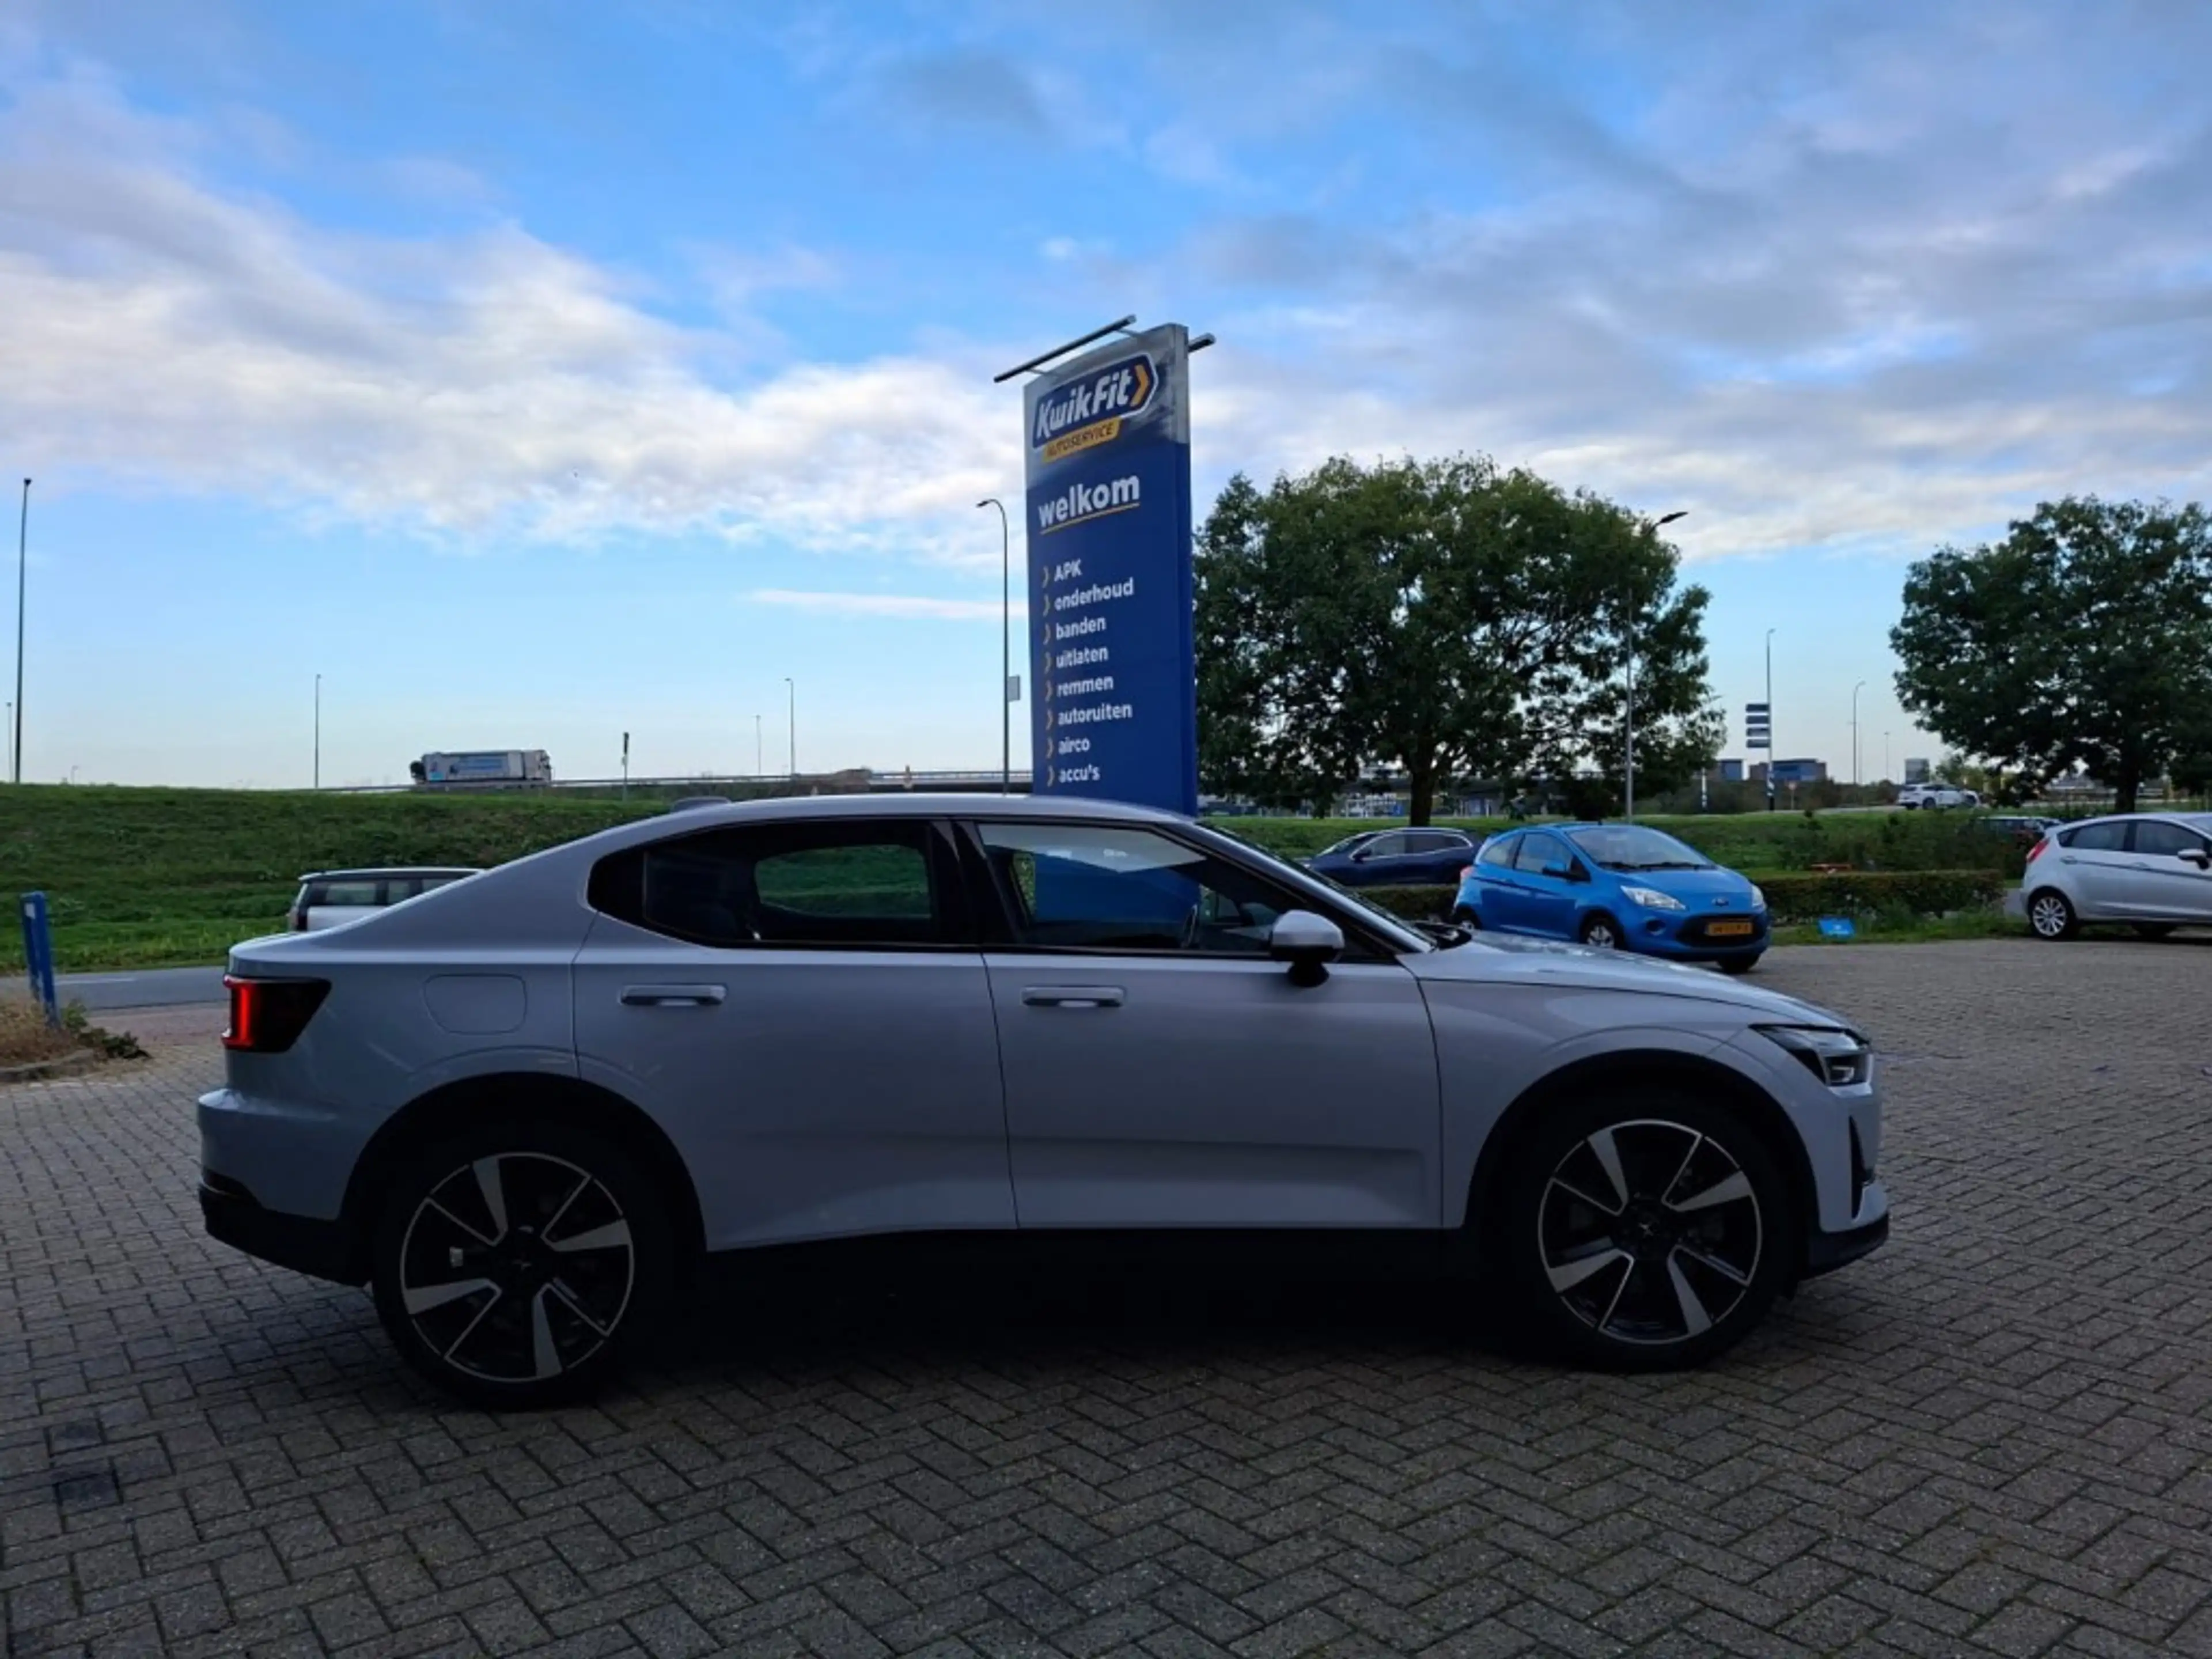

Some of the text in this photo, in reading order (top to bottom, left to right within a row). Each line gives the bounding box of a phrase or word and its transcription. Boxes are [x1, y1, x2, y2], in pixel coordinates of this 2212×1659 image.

[1046, 422, 1115, 456] AUTOSERVICE
[1038, 475, 1140, 527] welkom
[1054, 559, 1082, 582] APK
[1054, 577, 1135, 611] onderhoud
[1056, 616, 1107, 640] banden
[1056, 646, 1109, 669] uitlaten
[1056, 676, 1114, 697] remmen
[1058, 703, 1133, 726] autoruiten
[1058, 736, 1091, 755] airco
[1059, 764, 1100, 783] accu's
